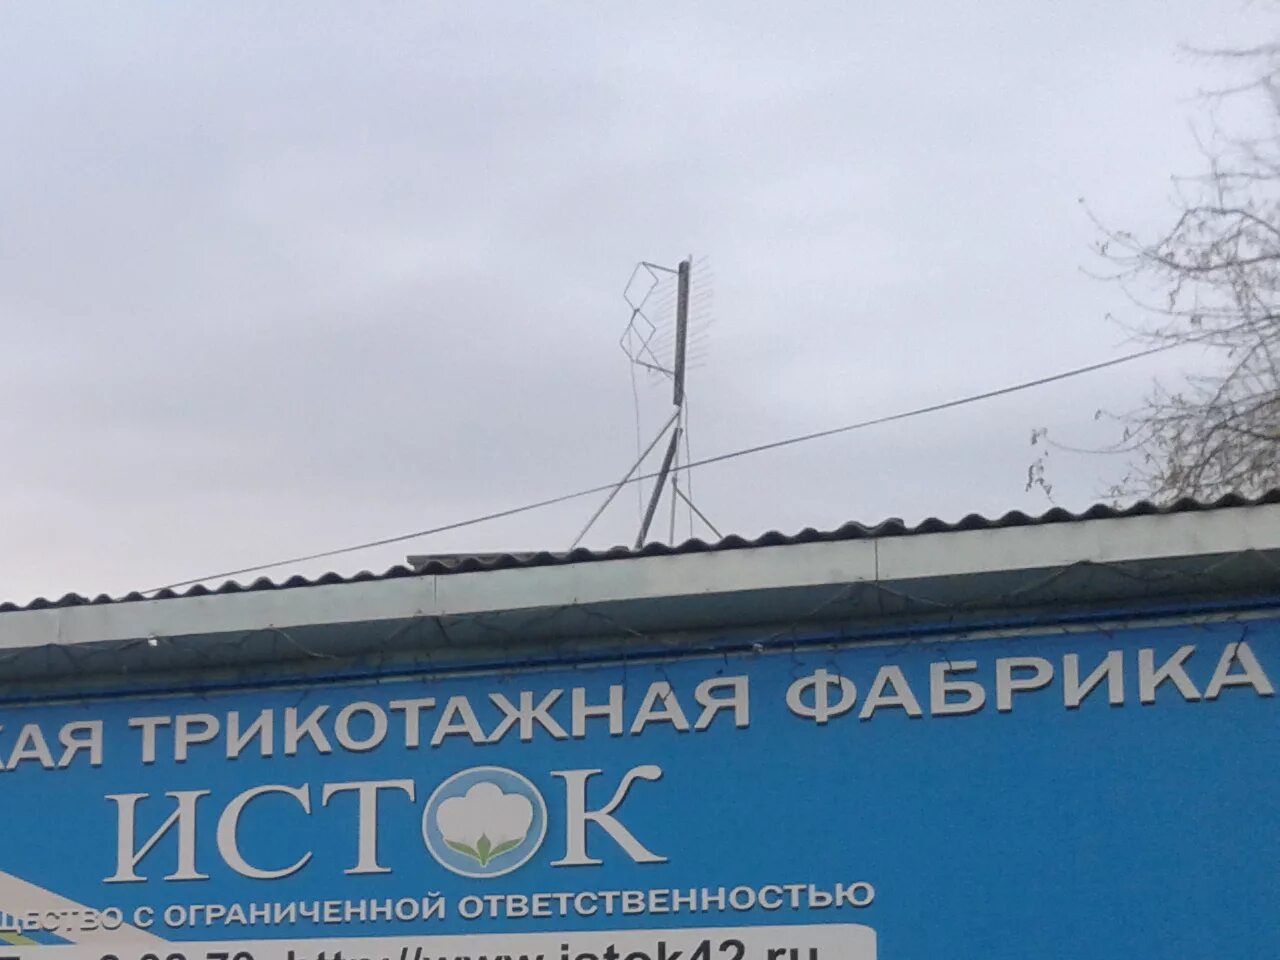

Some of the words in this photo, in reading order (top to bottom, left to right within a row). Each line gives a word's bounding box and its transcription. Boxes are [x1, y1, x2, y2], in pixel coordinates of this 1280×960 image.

[128, 674, 751, 764] ТРИКОТАЖНАЯ
[786, 641, 1275, 723] ФАБРИКА
[104, 764, 670, 880] ИСТОК
[133, 906, 155, 928] С
[163, 890, 446, 928] ОГРАНИЧЕННОЙ
[458, 881, 876, 920] ОТВЕТСТВЕННОСТЬЮ
